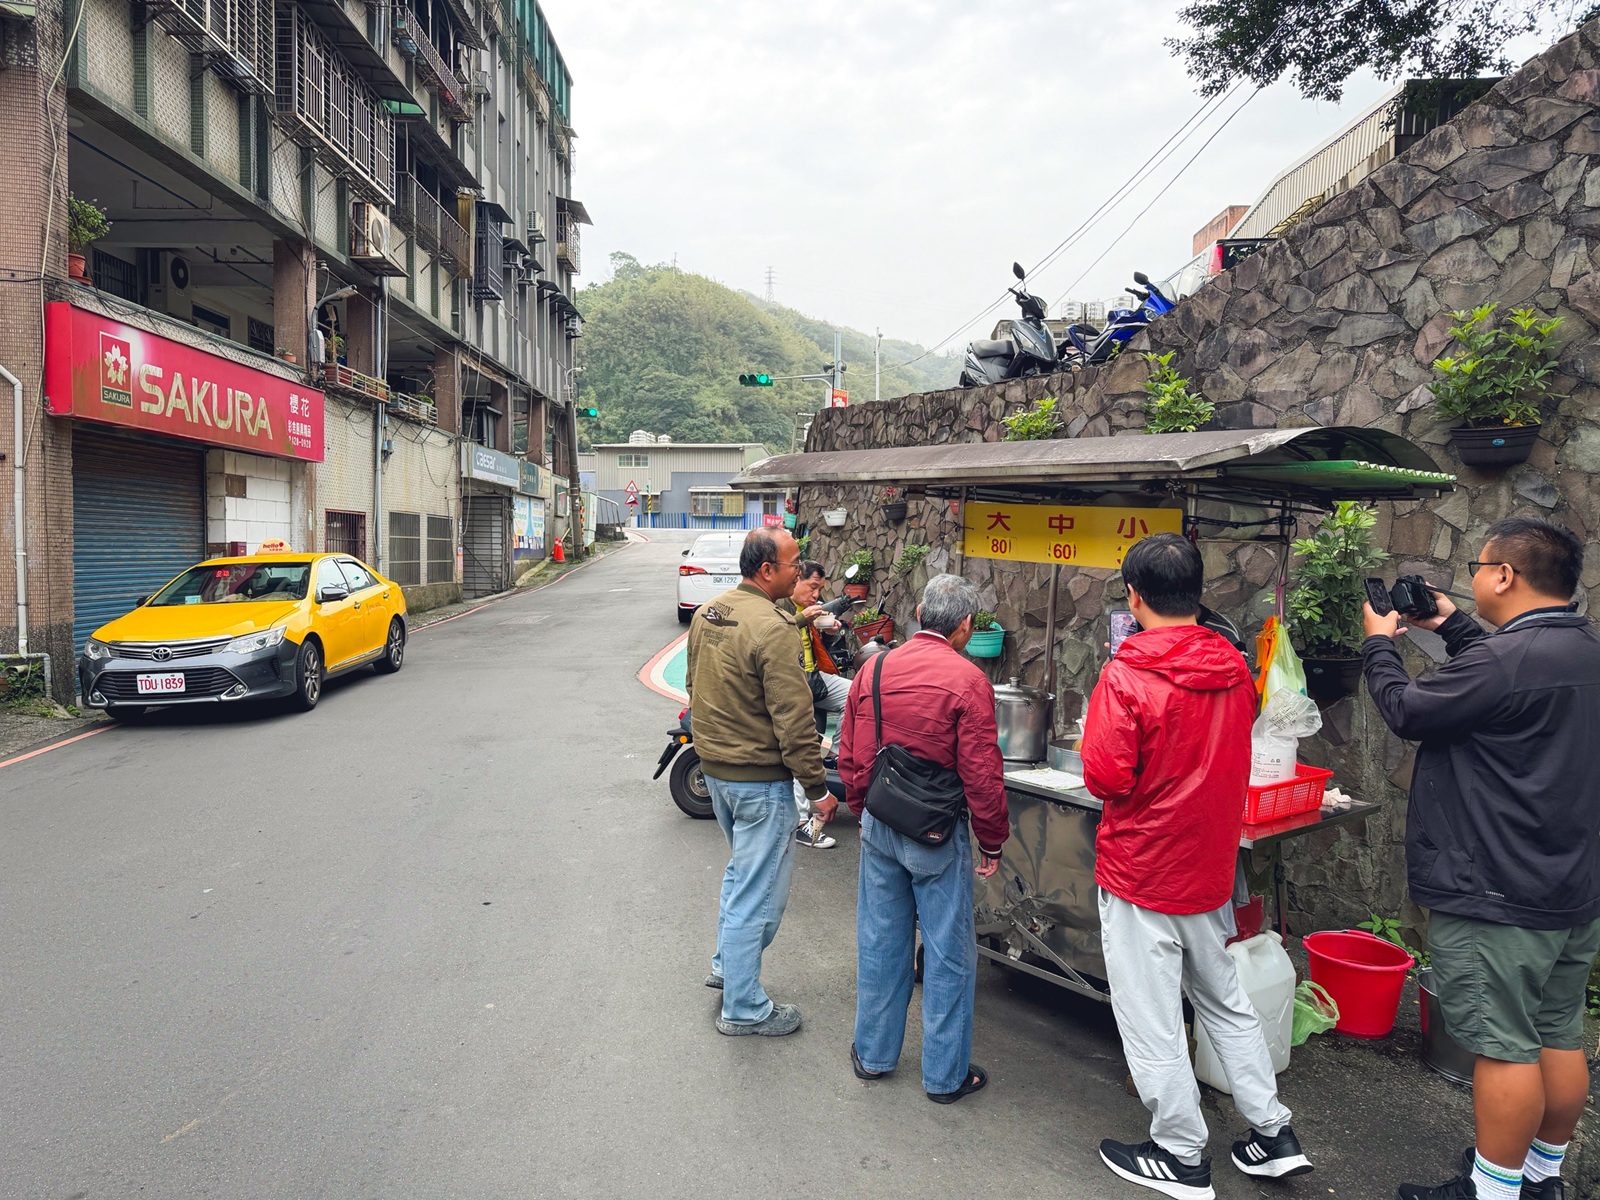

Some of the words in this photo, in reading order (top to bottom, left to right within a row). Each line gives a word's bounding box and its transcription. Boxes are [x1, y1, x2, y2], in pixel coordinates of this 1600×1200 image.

[103, 390, 131, 404] SAKURA
[139, 363, 273, 440] SAKURA
[289, 393, 310, 418] 櫻花
[987, 511, 1011, 531] 大
[1048, 514, 1075, 535] 中
[1116, 517, 1149, 539] 小
